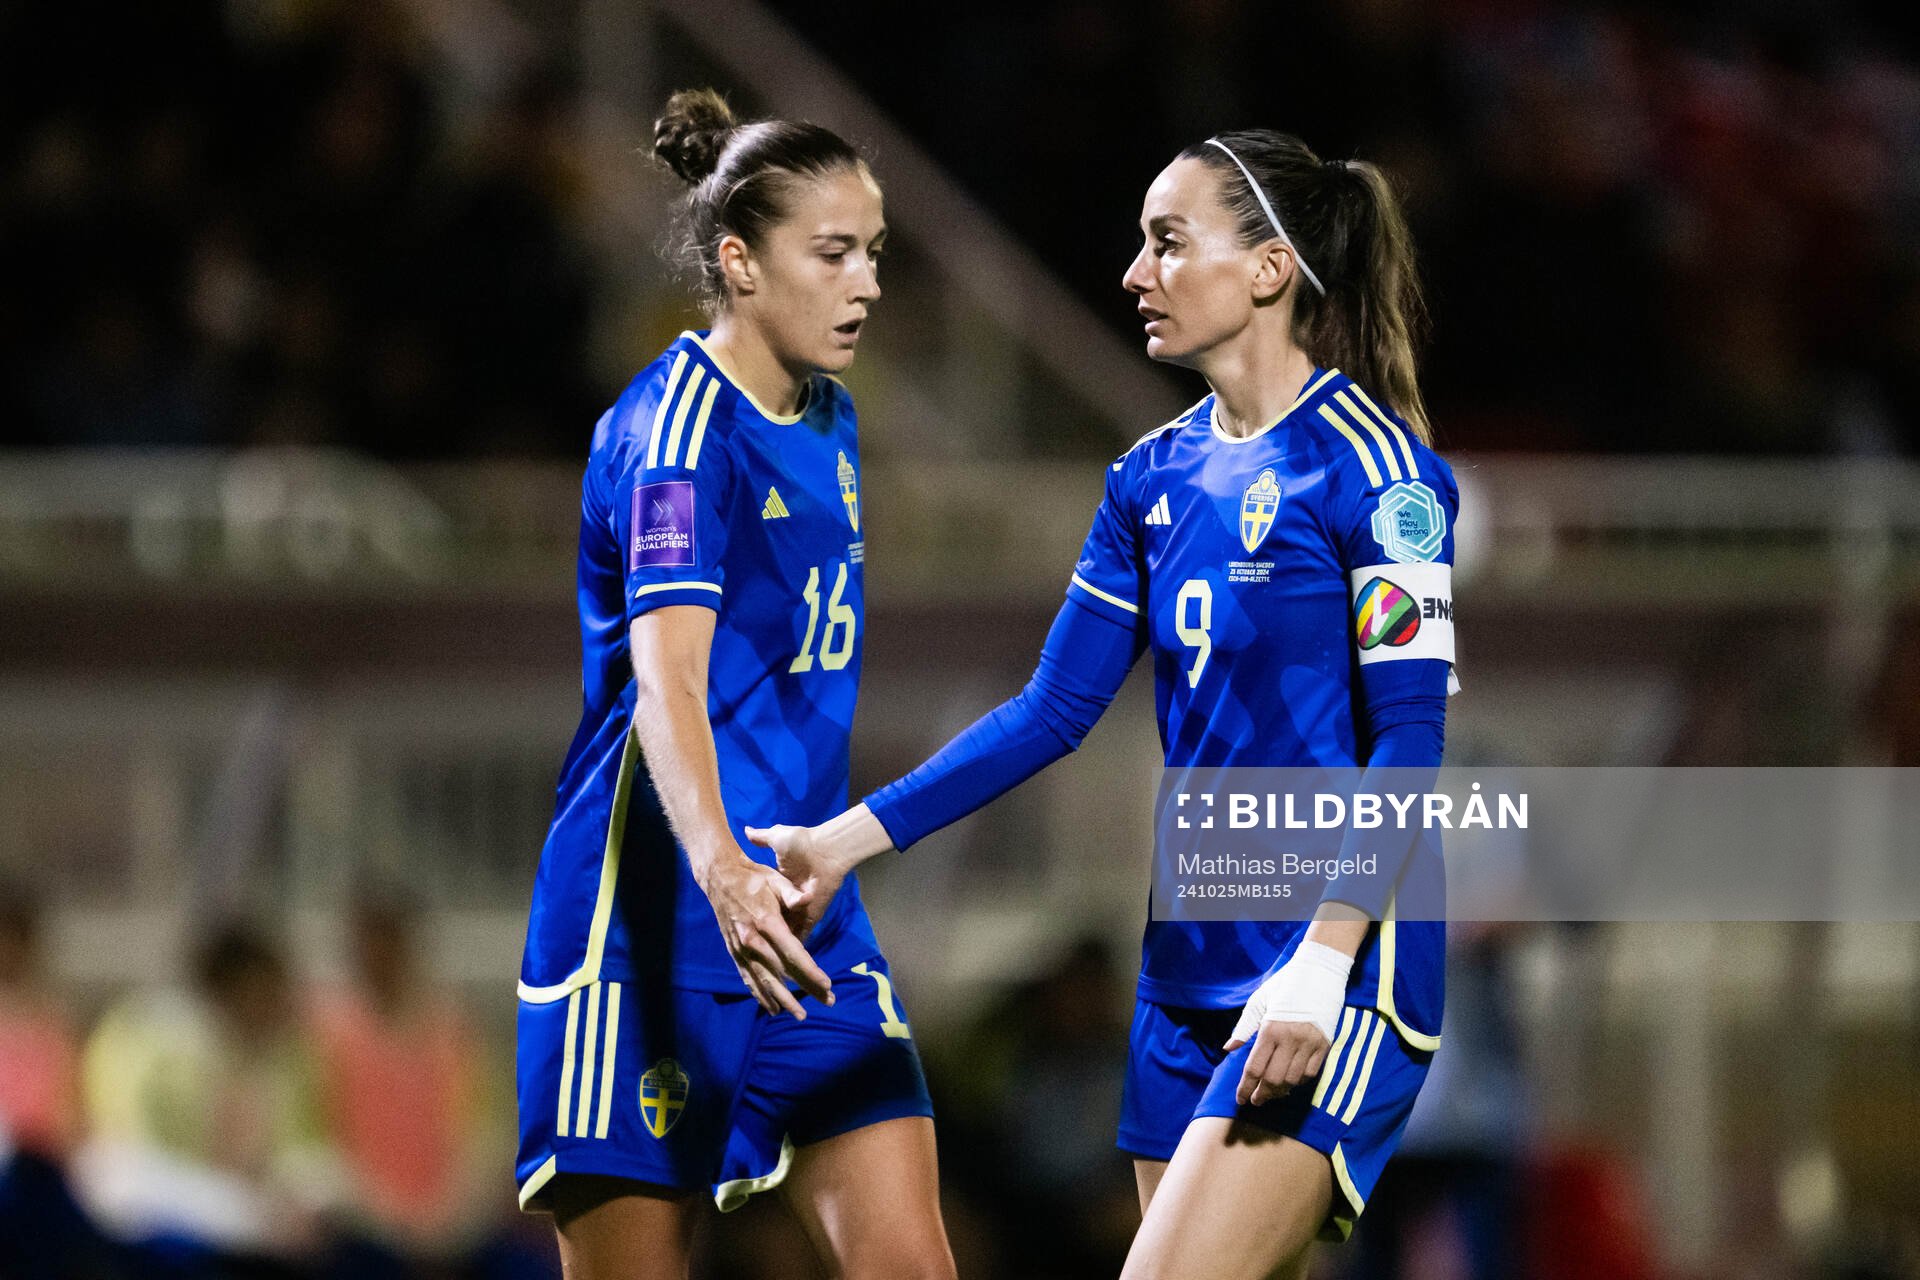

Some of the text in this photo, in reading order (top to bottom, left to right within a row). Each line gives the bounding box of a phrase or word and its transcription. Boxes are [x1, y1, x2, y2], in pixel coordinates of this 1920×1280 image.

[1397, 510, 1411, 518] We
[646, 525, 677, 534] women's
[1399, 519, 1418, 529] Play
[635, 532, 688, 545] EUROPEAN
[1400, 528, 1429, 538] Strong
[635, 540, 689, 552] QUALIFIERS
[788, 562, 856, 674] 16
[1175, 579, 1213, 689] 9
